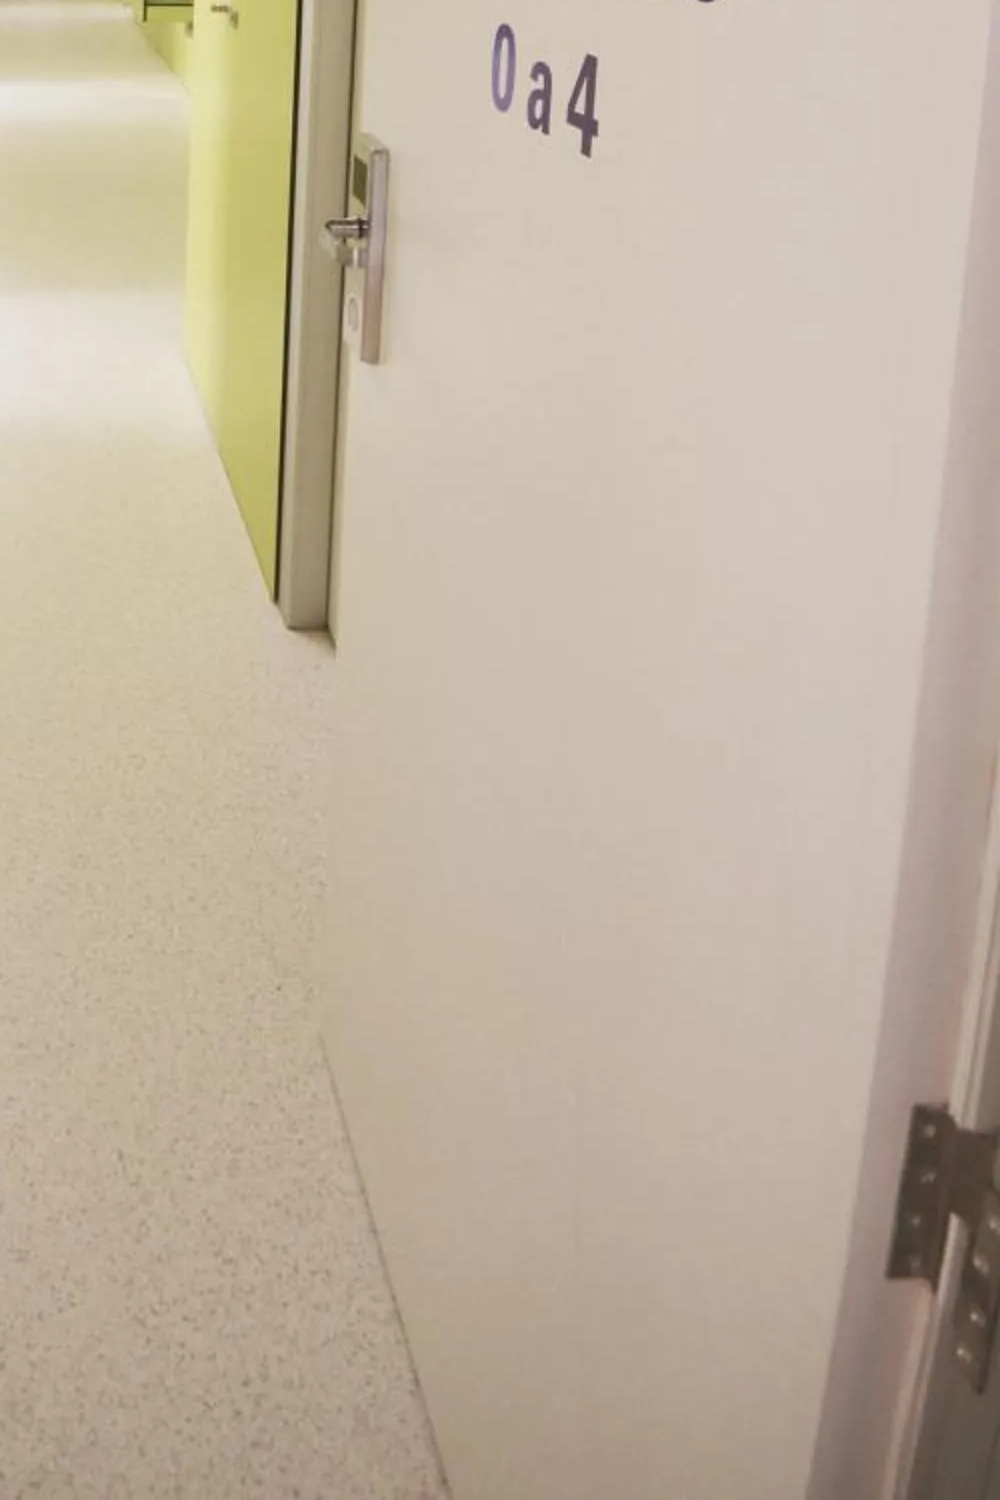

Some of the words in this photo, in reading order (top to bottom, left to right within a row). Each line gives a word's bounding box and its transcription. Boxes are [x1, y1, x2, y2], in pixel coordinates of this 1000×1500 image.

[491, 23, 516, 113] 0
[527, 61, 553, 135] a
[566, 53, 599, 158] 4
